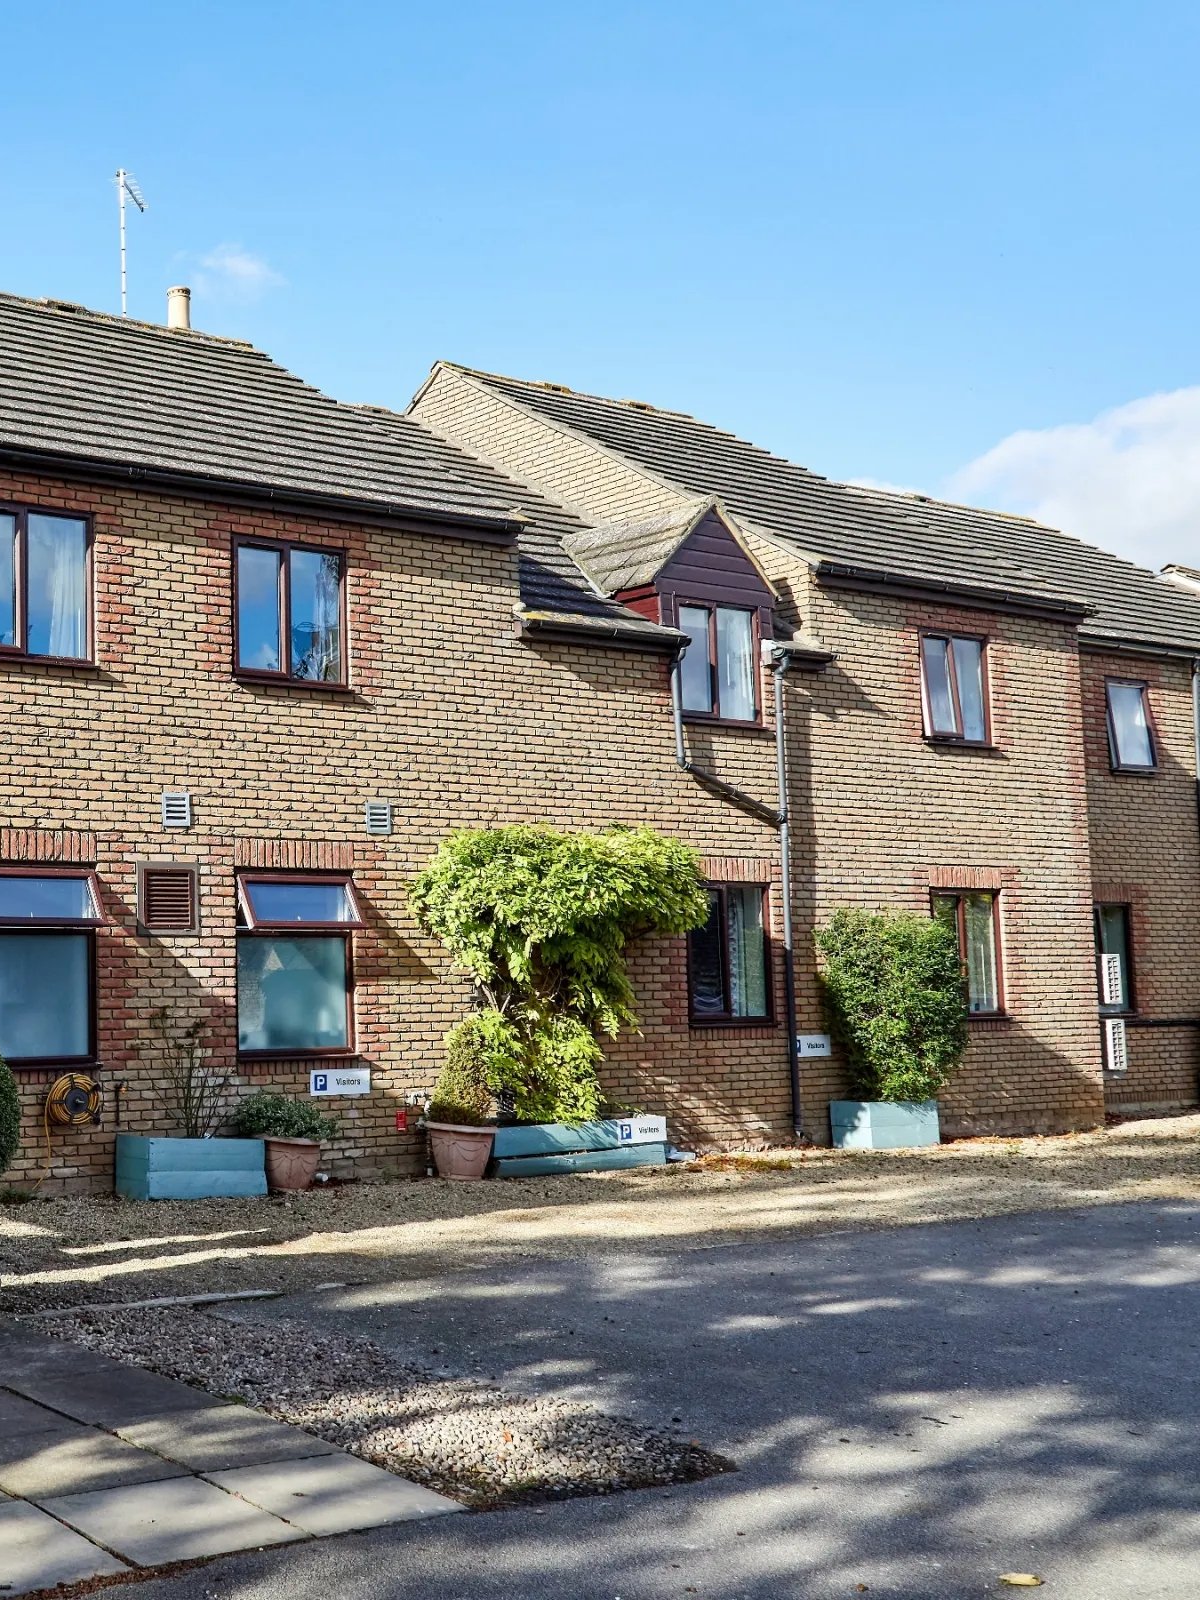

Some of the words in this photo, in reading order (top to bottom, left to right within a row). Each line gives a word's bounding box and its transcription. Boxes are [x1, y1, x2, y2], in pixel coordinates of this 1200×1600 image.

[316, 1076, 325, 1090] P
[335, 1077, 361, 1086] Visitors
[622, 1125, 630, 1139] P
[638, 1126, 660, 1134] Visitors
